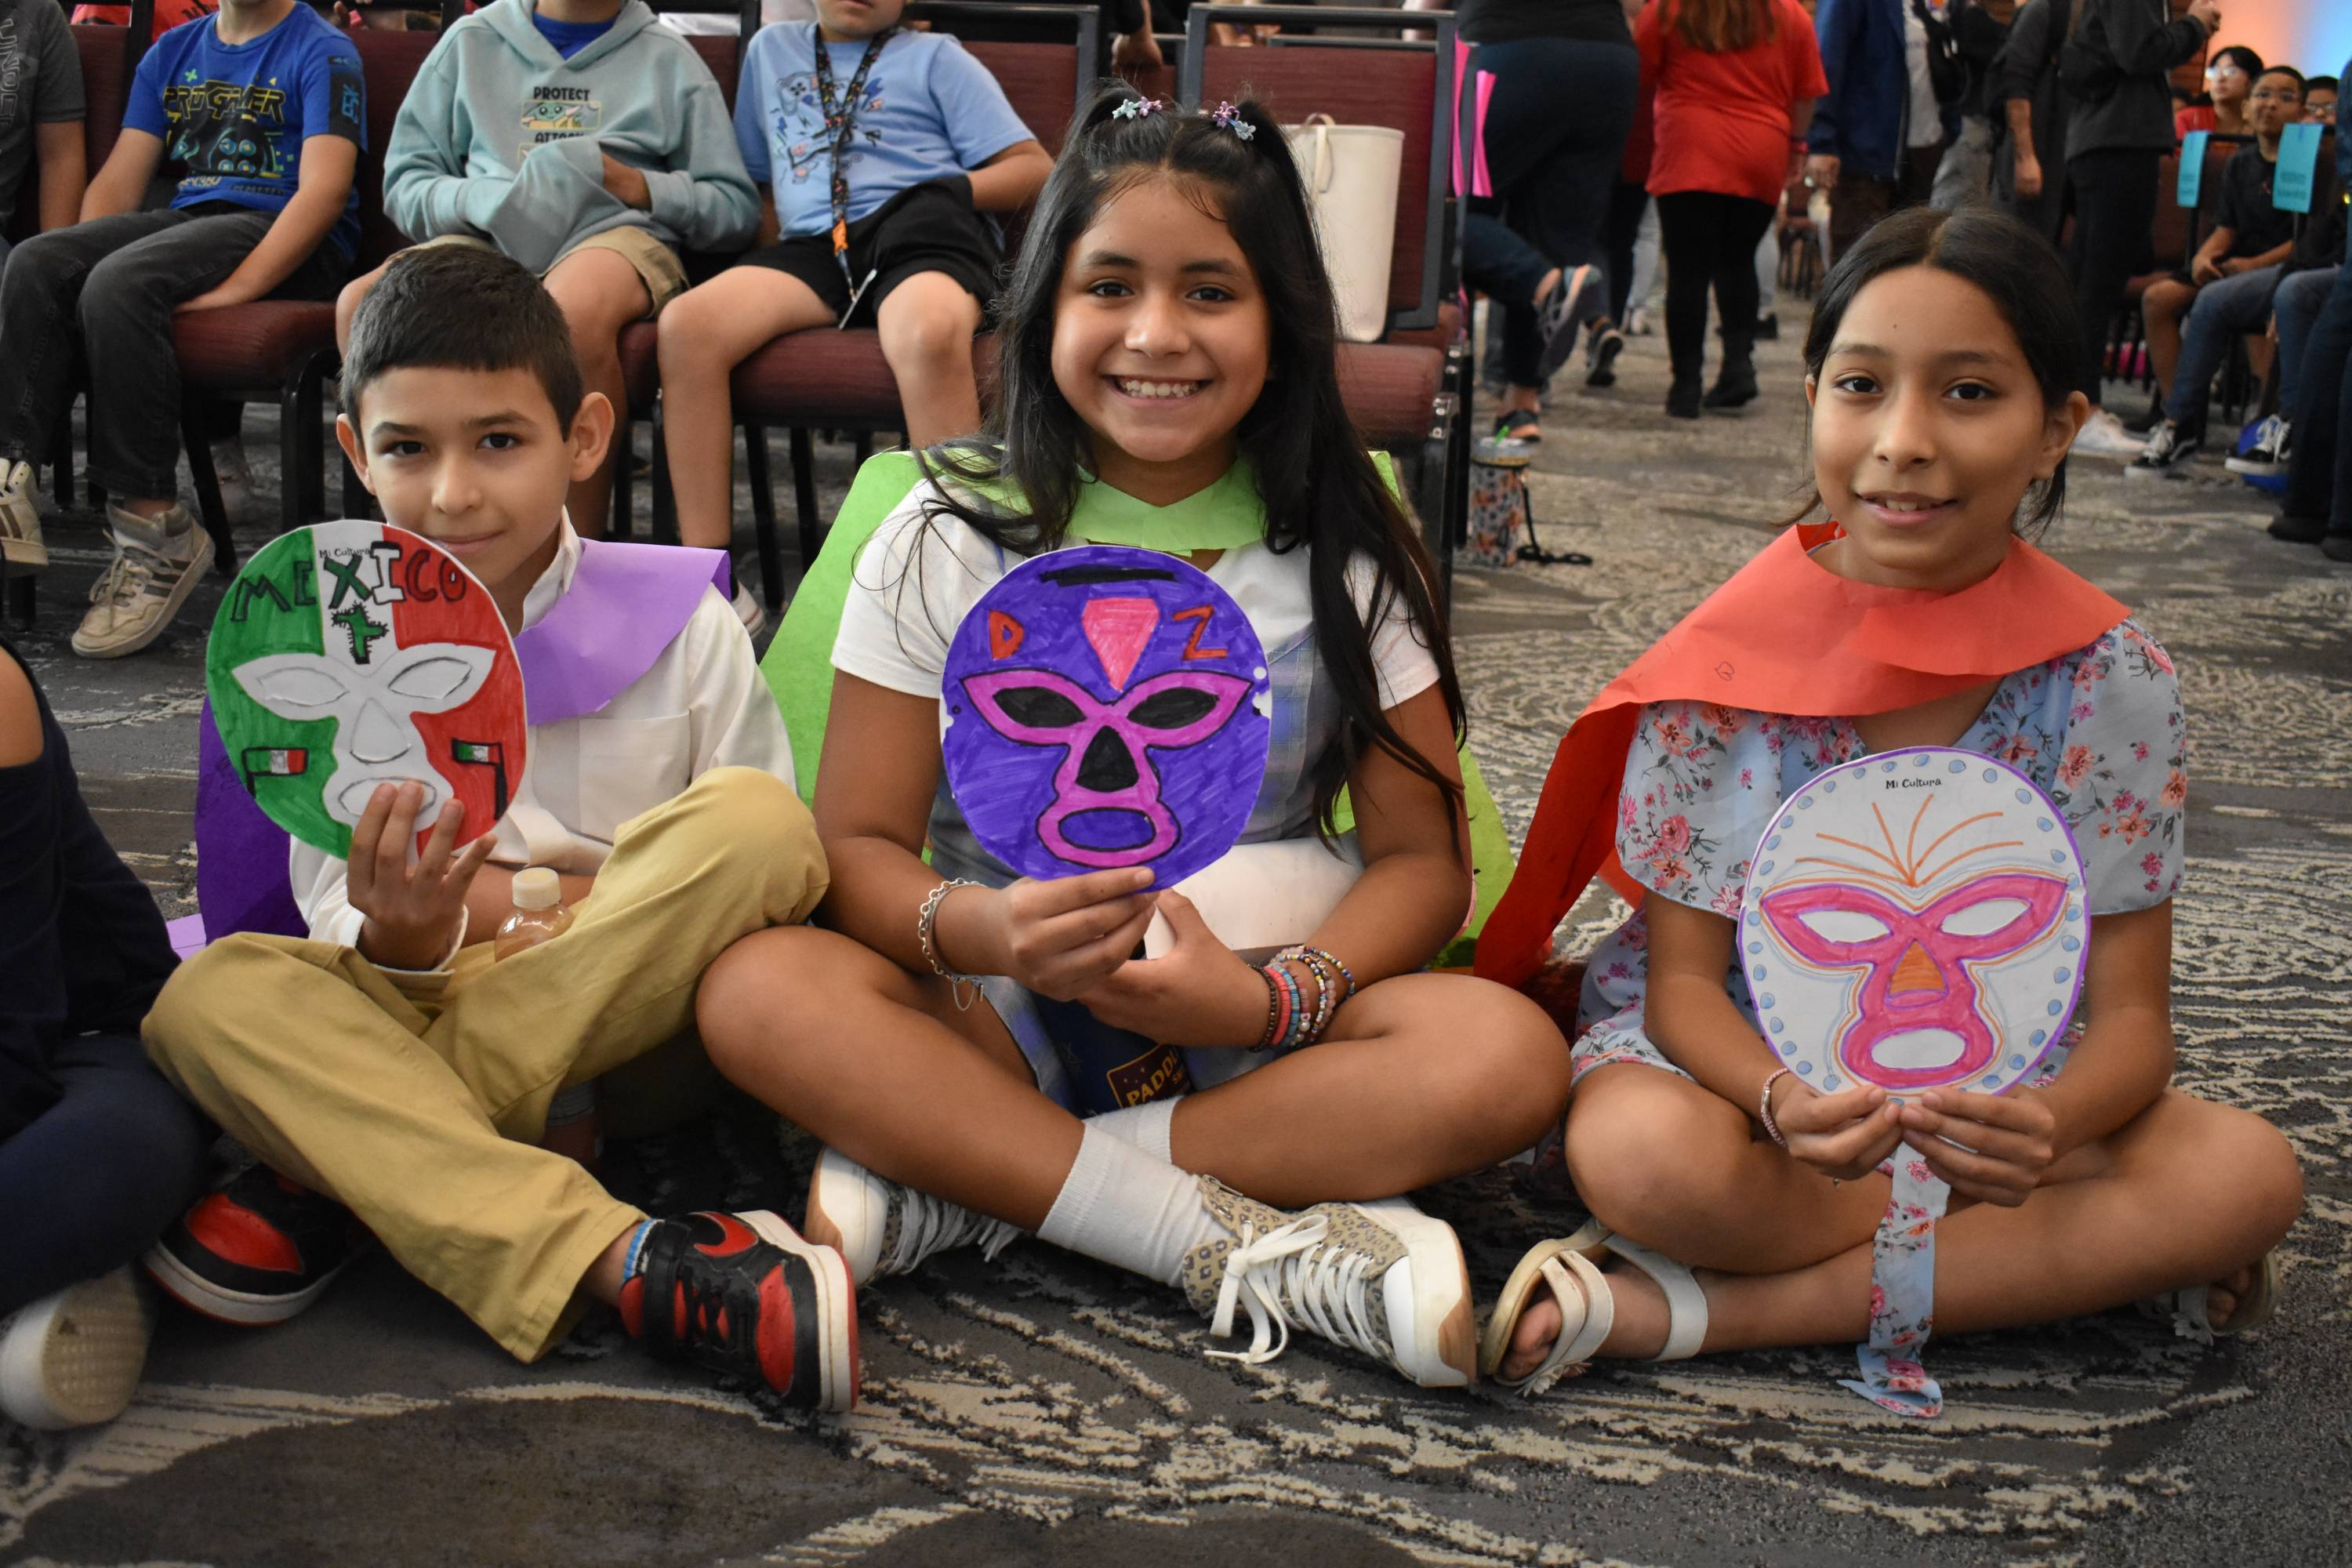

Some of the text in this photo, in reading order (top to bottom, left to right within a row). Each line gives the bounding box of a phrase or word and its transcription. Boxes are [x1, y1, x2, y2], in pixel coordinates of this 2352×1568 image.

[534, 86, 590, 101] PROTECT
[535, 132, 586, 143] ATT
[319, 547, 372, 559] Mi Cultura
[230, 540, 467, 622] MEXICO
[988, 604, 1229, 661] D Z
[1886, 777, 1943, 789] Mi Cultura
